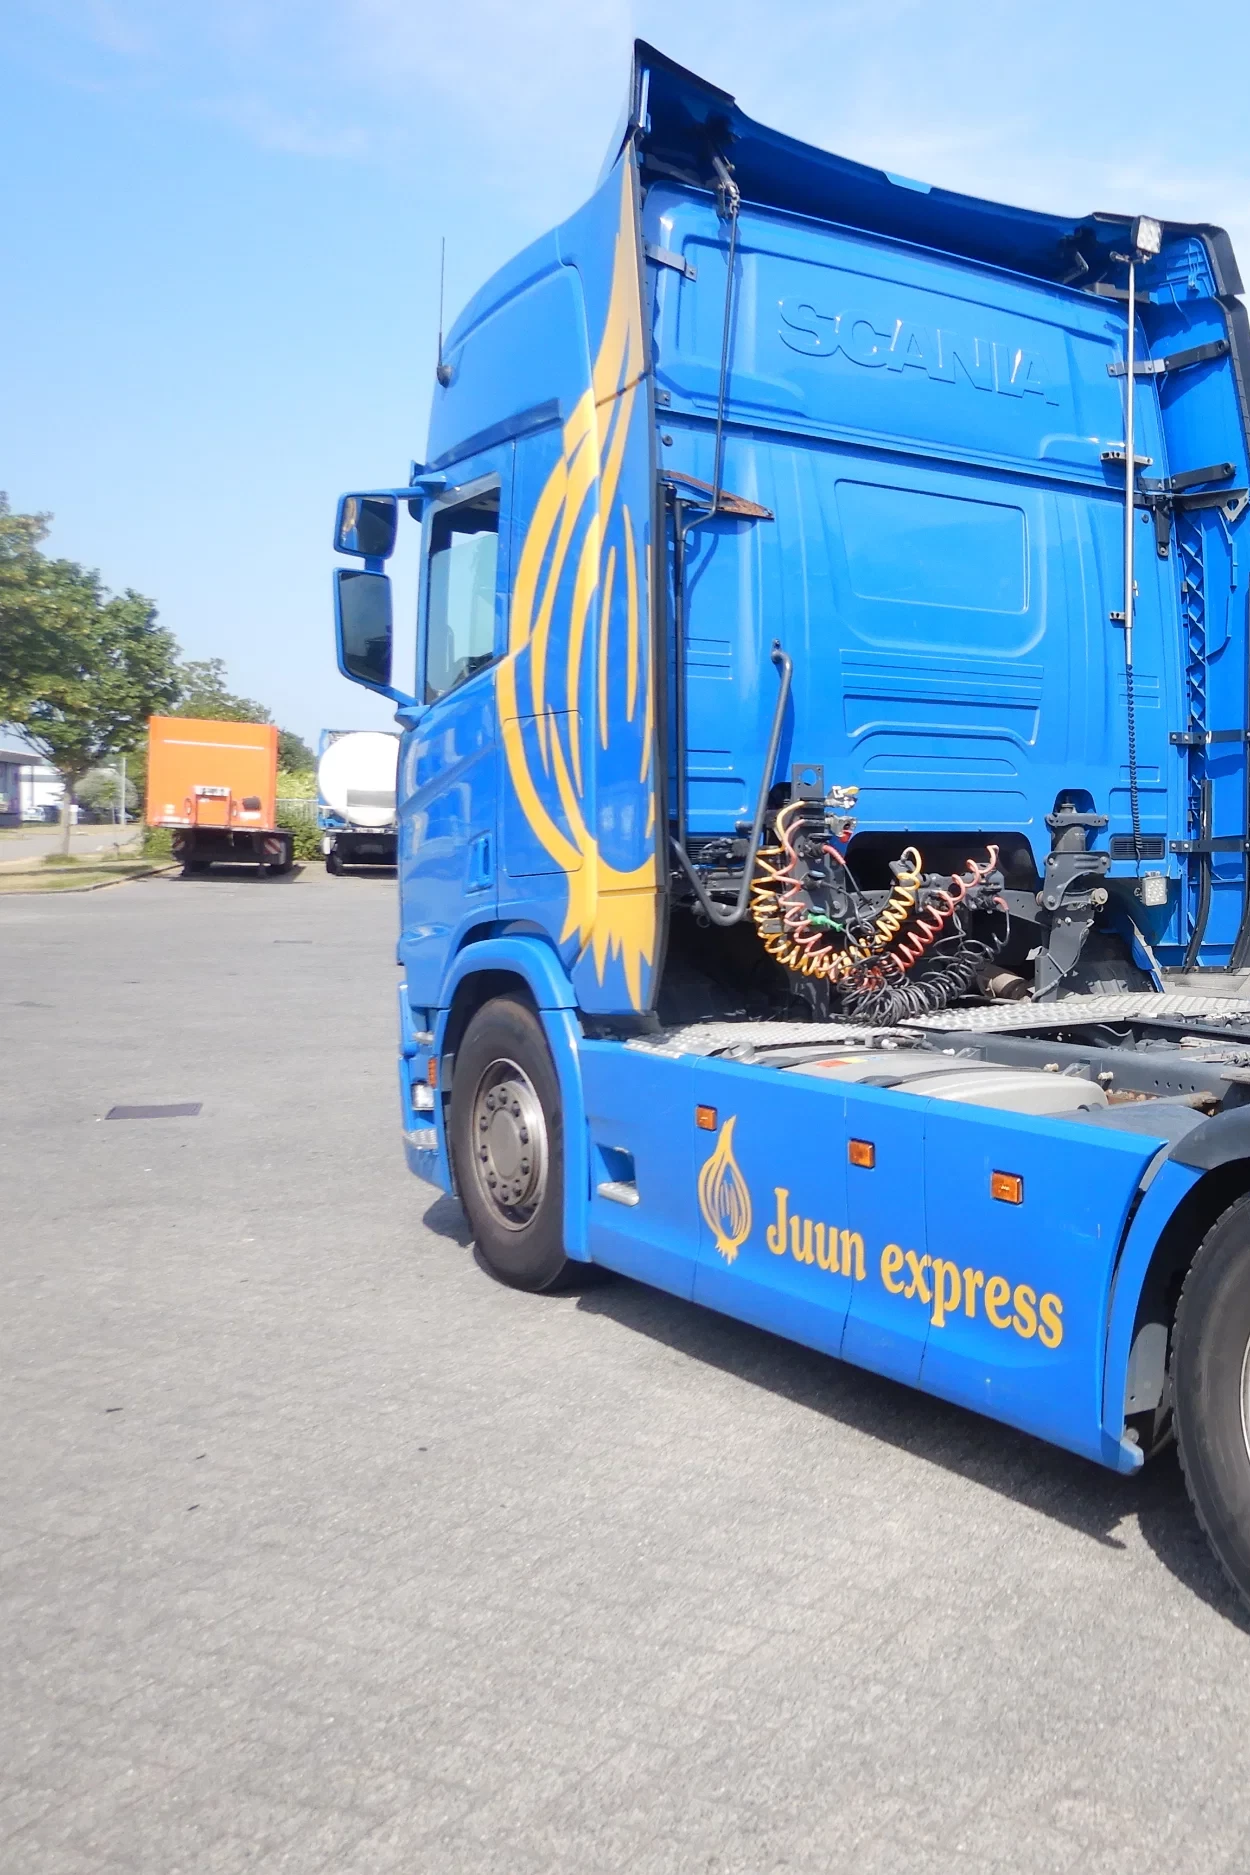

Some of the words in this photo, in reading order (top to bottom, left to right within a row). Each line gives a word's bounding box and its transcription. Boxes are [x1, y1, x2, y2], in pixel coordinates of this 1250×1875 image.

[778, 295, 1060, 407] SCANIA
[766, 1187, 866, 1282] Juun
[881, 1243, 1063, 1349] express
